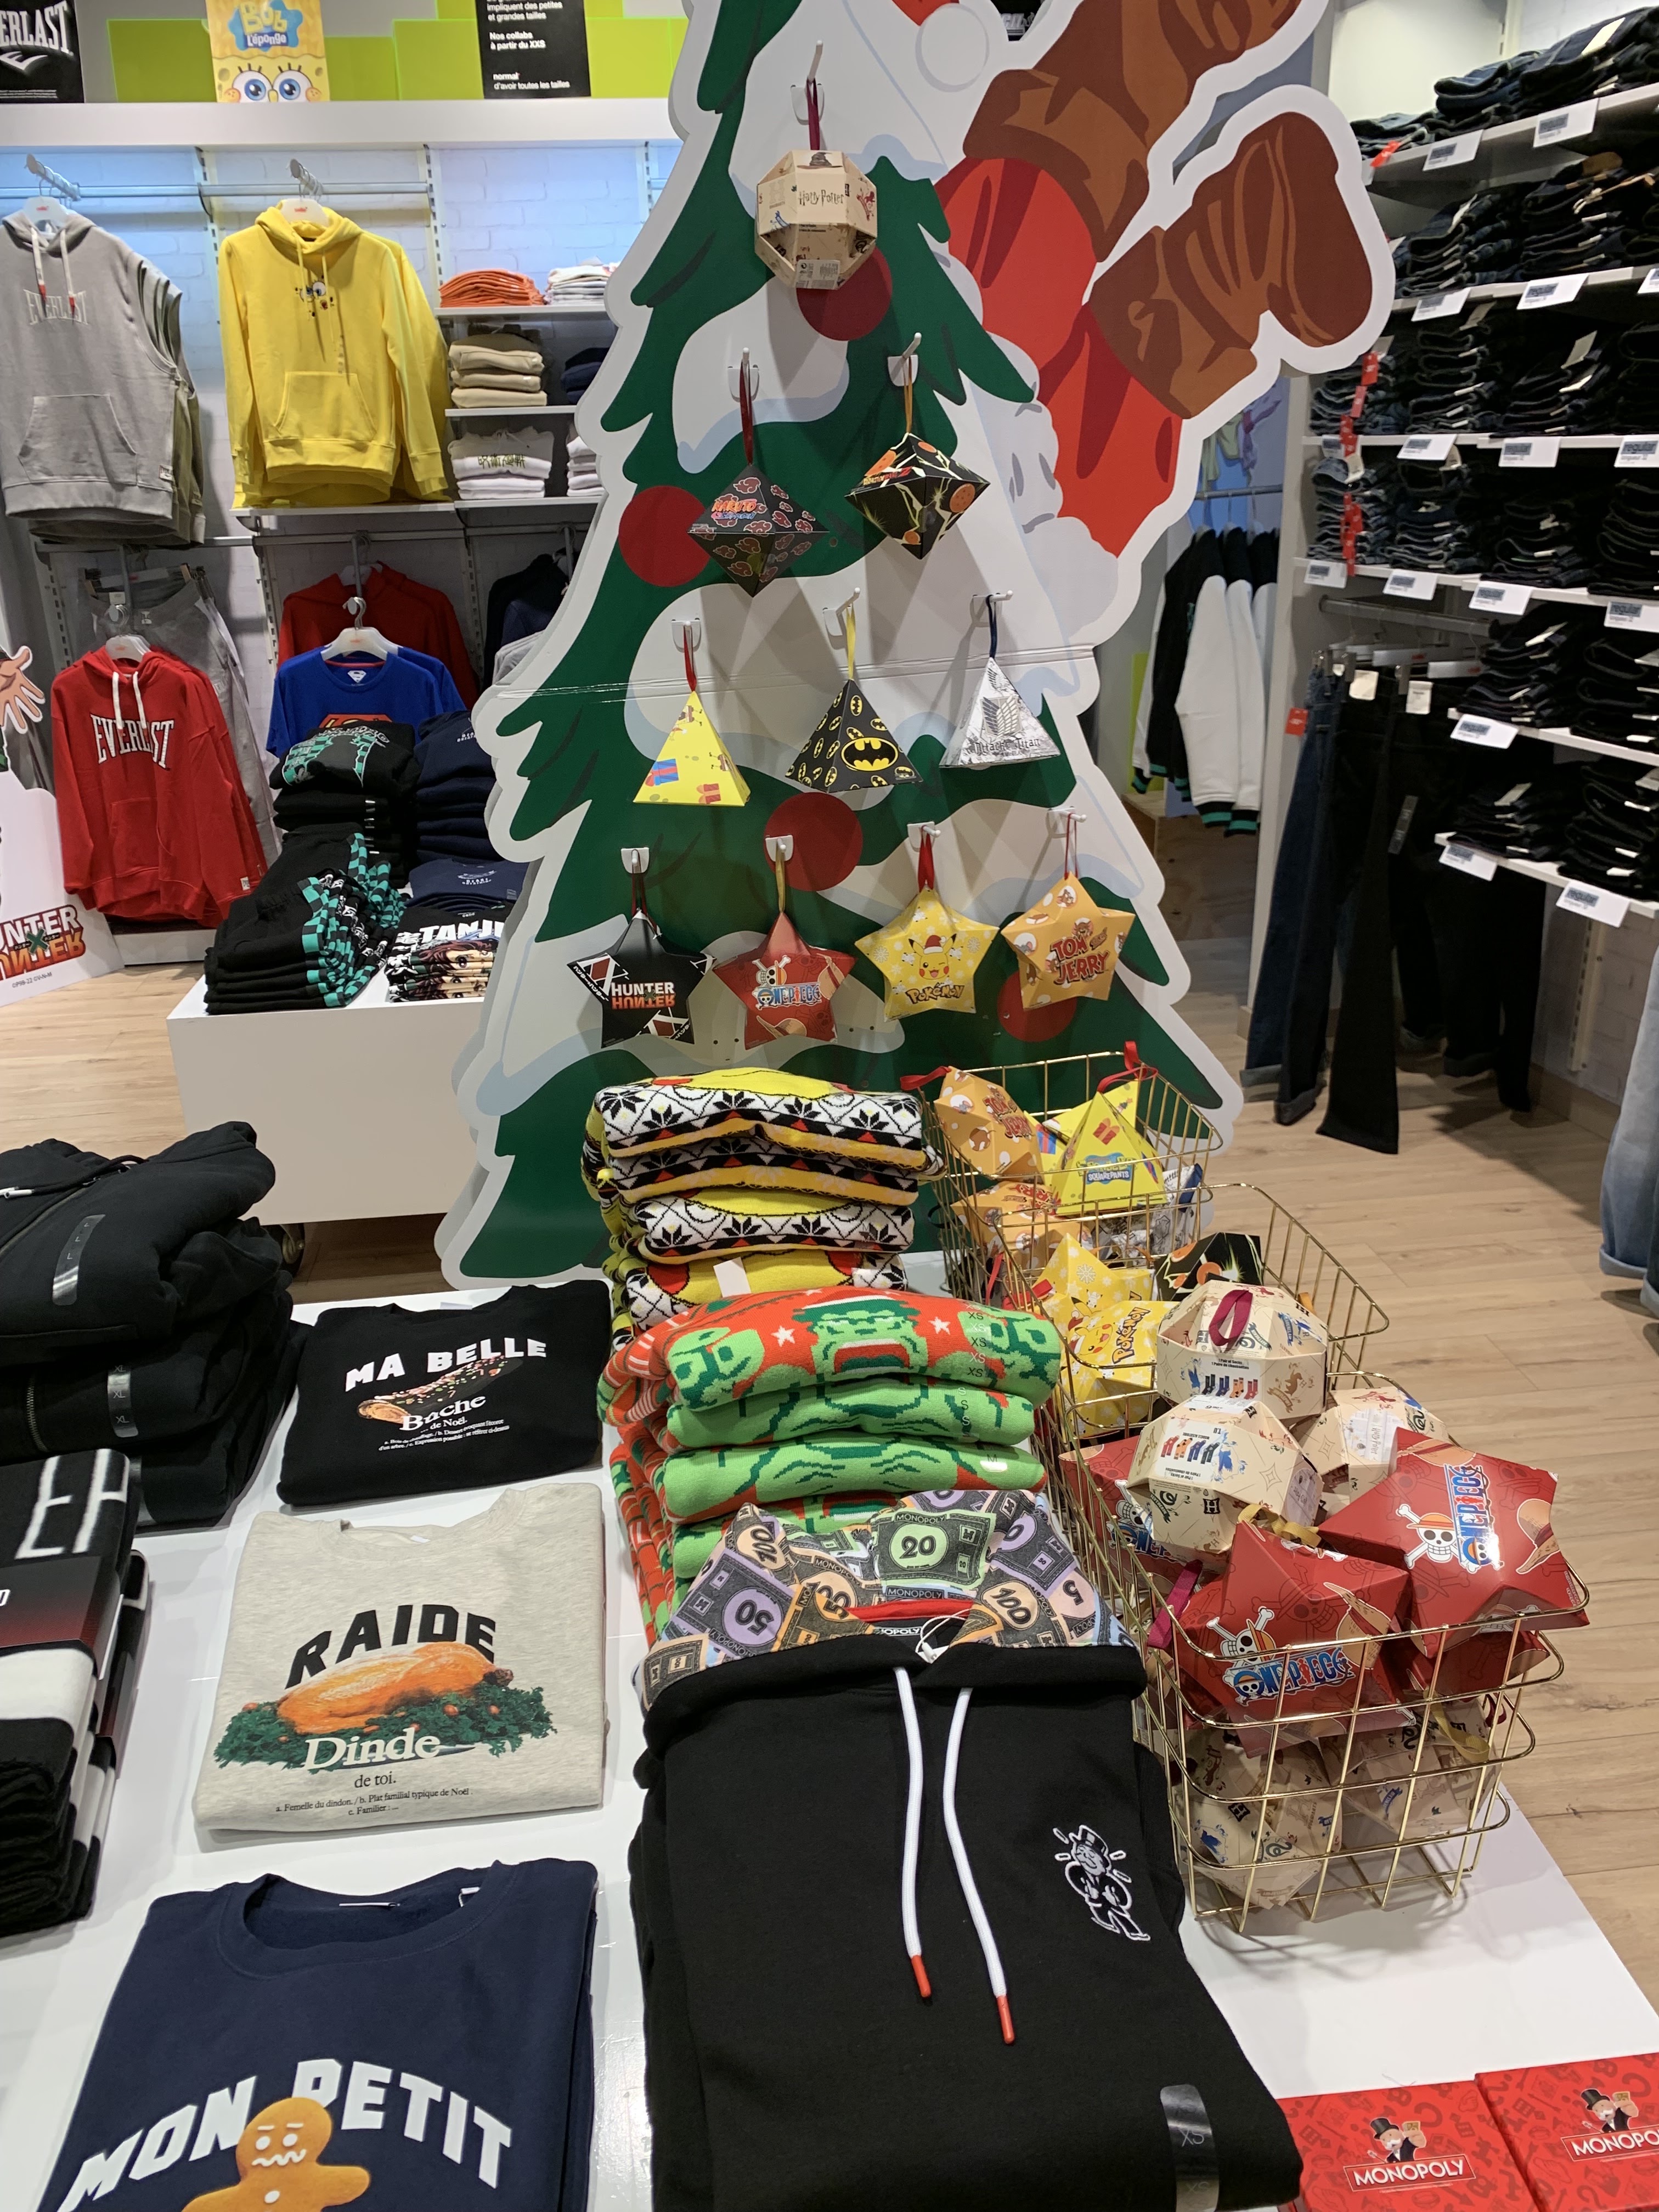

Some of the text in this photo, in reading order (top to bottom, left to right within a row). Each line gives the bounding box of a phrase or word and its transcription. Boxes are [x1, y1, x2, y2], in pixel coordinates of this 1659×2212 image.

[487, 3, 523, 12] impliquent
[539, 1, 563, 10] petites
[240, 2, 287, 35] Bob
[496, 13, 525, 22] grandes
[526, 12, 546, 20] tailles
[247, 33, 287, 47] L'éponge
[489, 31, 533, 41] Nos collabs
[497, 41, 517, 50] partir
[518, 41, 529, 49] du
[529, 40, 546, 49] XXS
[798, 189, 844, 206] Harry Potter
[712, 499, 757, 512] NARUTO
[1050, 935, 1088, 961] TOM
[1053, 950, 1110, 986] JERRY
[611, 981, 675, 996] HUNTER
[1088, 1170, 1130, 1181] SQUAREPANTS
[968, 1312, 984, 1320] XS
[970, 1323, 986, 1332] XS
[971, 1338, 987, 1347] XS
[345, 1337, 547, 1392] MA BELLE
[970, 1353, 986, 1363] XS
[967, 1368, 984, 1378] XS
[112, 1389, 126, 1399] XL
[958, 1387, 966, 1396] S
[961, 1401, 969, 1410] S
[116, 1415, 130, 1424] XL
[443, 1416, 469, 1428] Noël.
[962, 1415, 970, 1425] S
[409, 1432, 435, 1443] chauffage.
[444, 1427, 464, 1436] Dessert
[463, 1422, 486, 1432] évoquant
[415, 1437, 443, 1445] Expression
[443, 1434, 463, 1443] possible
[488, 1425, 510, 1434] ci-dessus
[896, 1515, 945, 1524] MONOPOLY
[899, 1535, 936, 1559] 20
[815, 1558, 862, 1587] MONOPOLY
[887, 1588, 943, 1599] MONOPOLY
[989, 1587, 1032, 1624] 100
[284, 1604, 497, 1690] RAIDE
[302, 1727, 441, 1771] Dinde
[354, 1771, 397, 1788] de toi.
[284, 1802, 314, 1812] Femelle
[315, 1799, 325, 1808] du
[326, 1798, 353, 1808] dindon.
[368, 1794, 383, 1803] Plat
[384, 1791, 410, 1801] familial
[411, 1790, 439, 1800] typique
[439, 1788, 449, 1797] de
[356, 1804, 387, 1815] Familier
[55, 2058, 512, 2212] MON PETIT
[1179, 2129, 1204, 2147] XS
[1571, 2129, 1659, 2157] MONOPO
[1352, 2159, 1464, 2187] MONOPOLY
